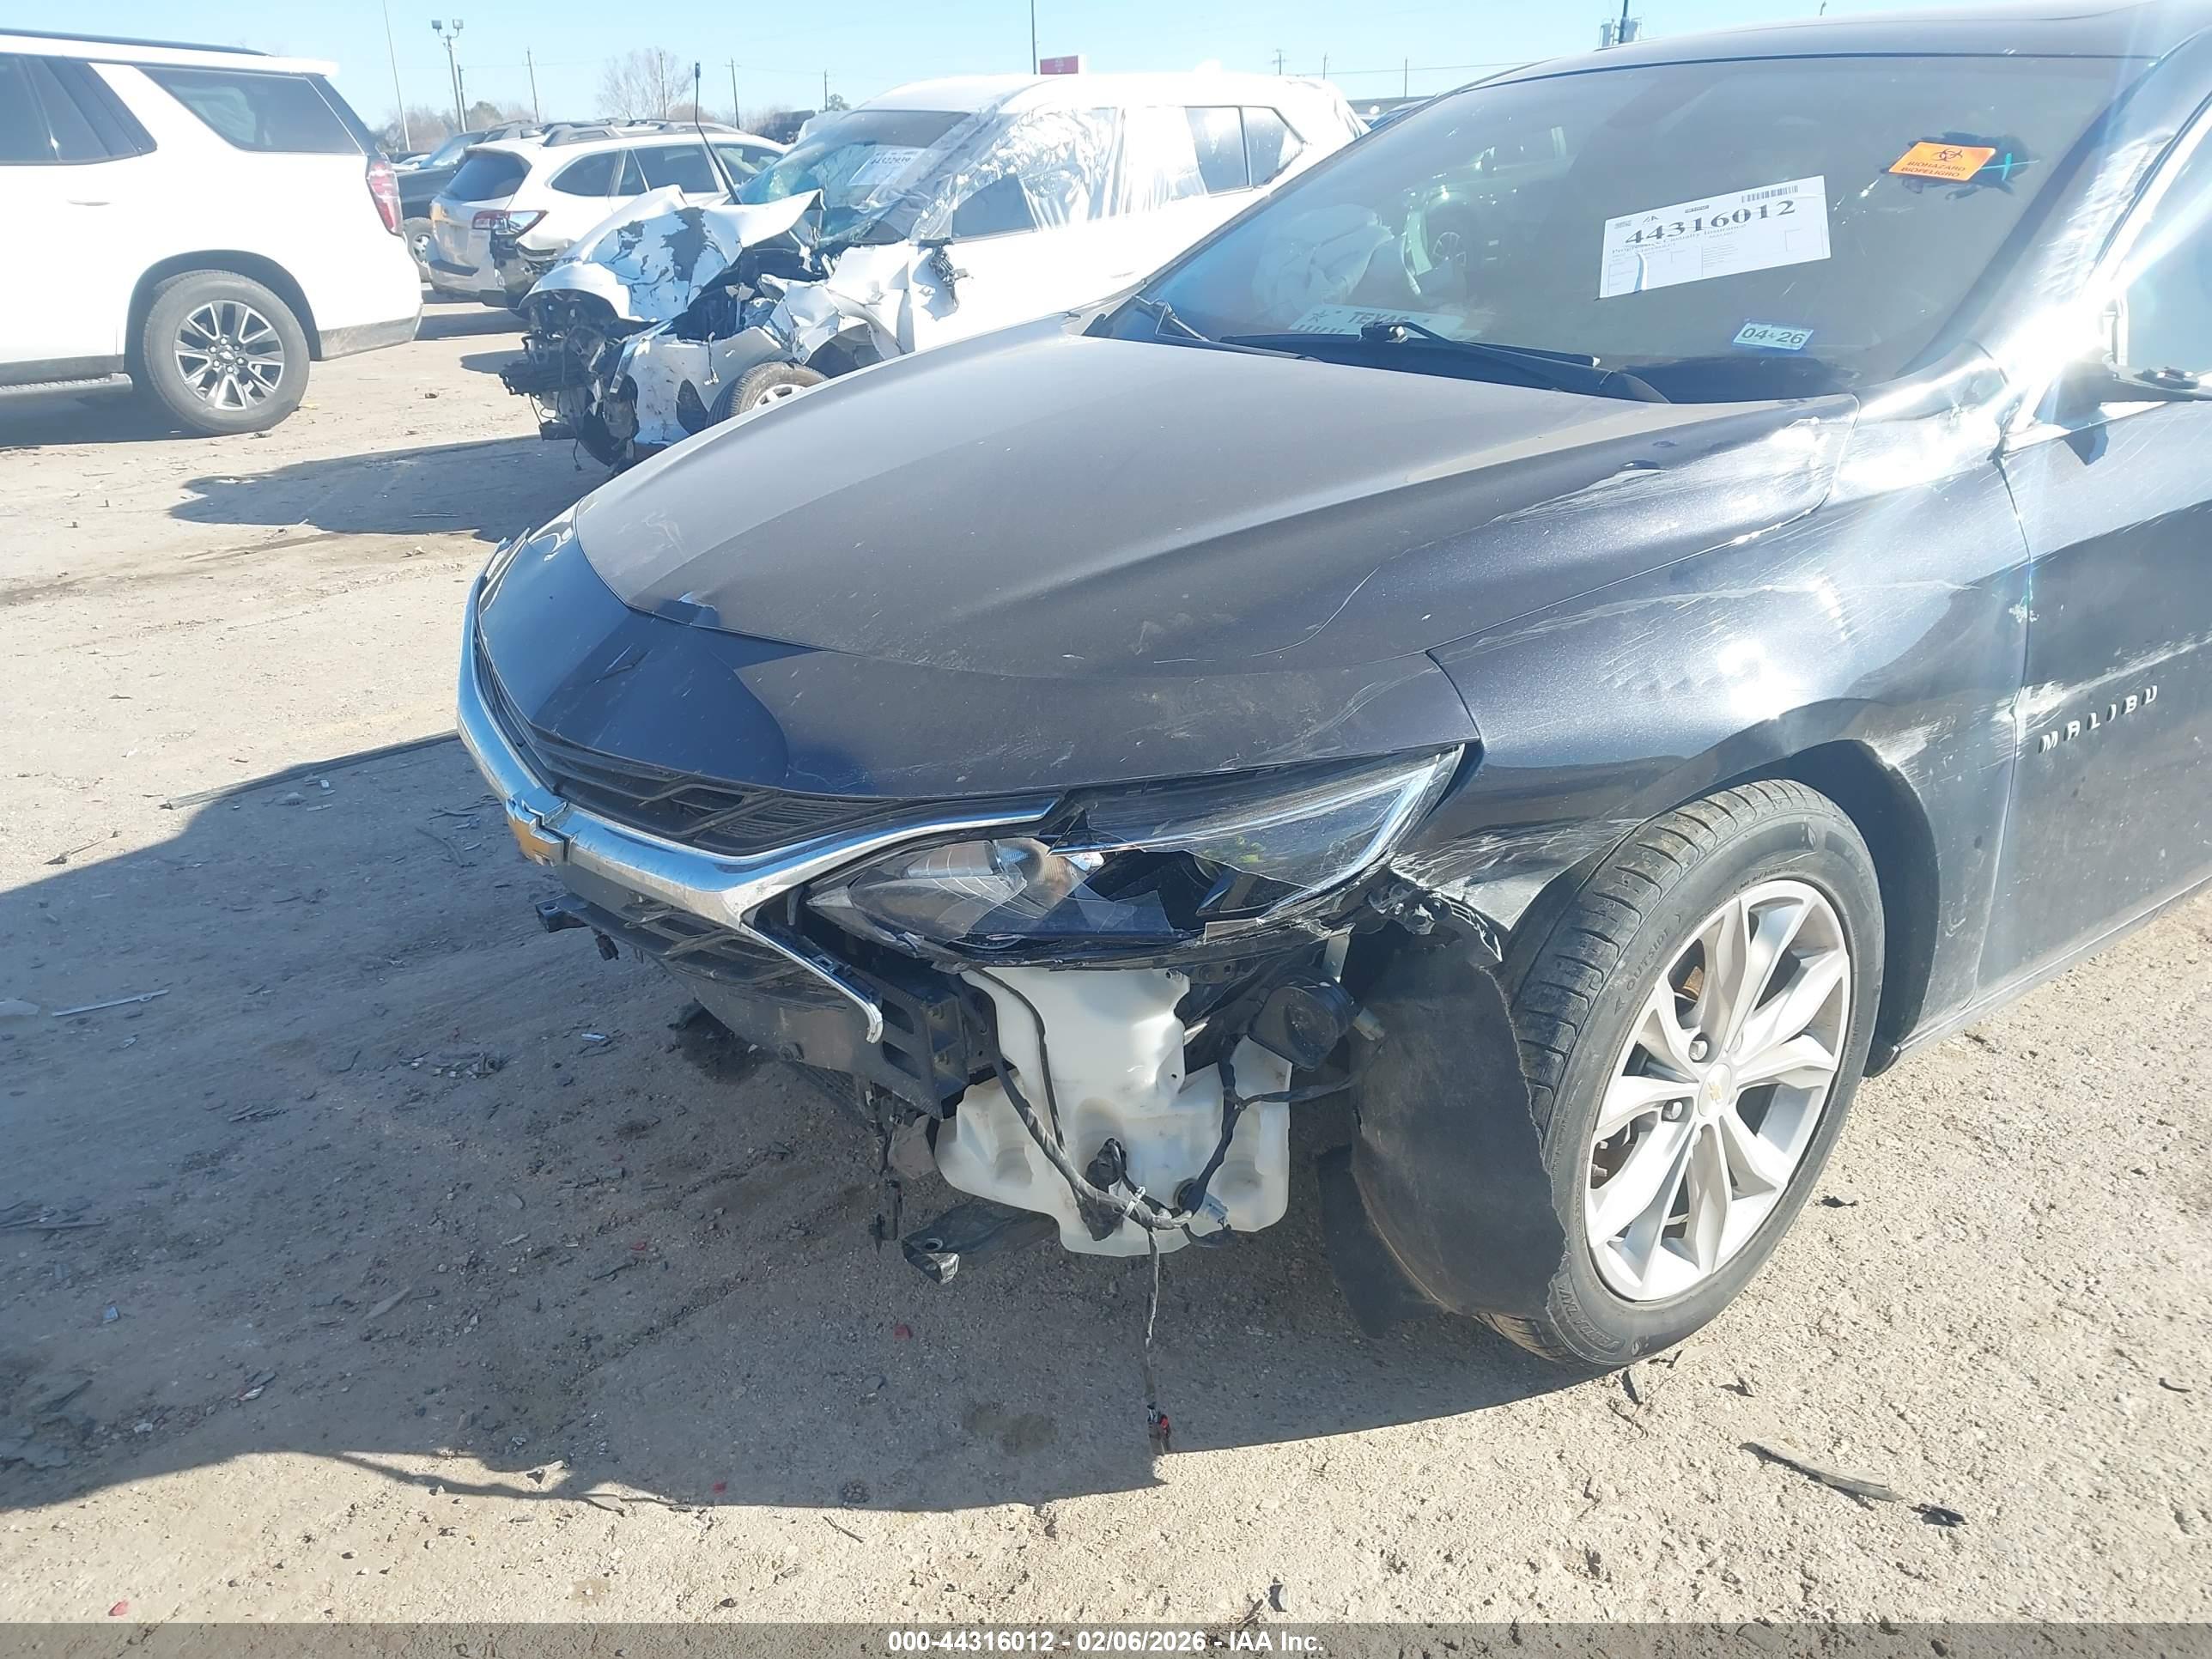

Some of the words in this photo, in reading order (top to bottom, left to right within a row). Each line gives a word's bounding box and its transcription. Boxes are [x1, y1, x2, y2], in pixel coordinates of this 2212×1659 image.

[1900, 167, 1960, 177] BIOPELIGRO
[1906, 161, 1966, 172] BIOHAZARD
[1625, 199, 1796, 245] 44316012
[2039, 685, 2158, 753] MALIBU
